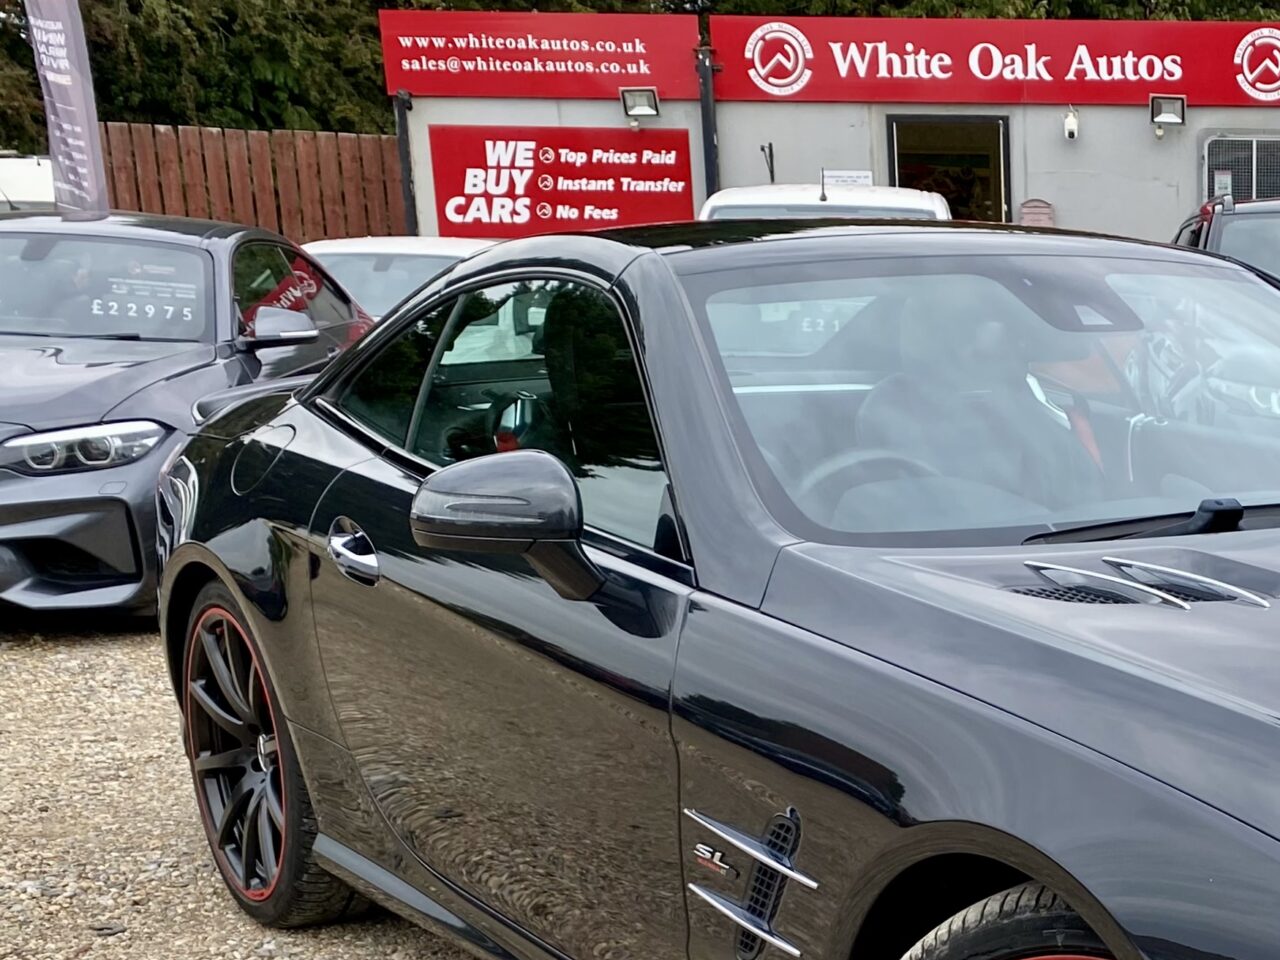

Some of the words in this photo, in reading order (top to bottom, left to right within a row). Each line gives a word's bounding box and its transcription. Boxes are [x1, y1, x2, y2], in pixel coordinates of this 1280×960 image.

[399, 33, 646, 53] www.whiteoakautos.co.uk
[401, 55, 651, 74] sales@whiteoakautos.co.uk
[828, 40, 953, 79] White
[968, 43, 1053, 81] Oak
[1065, 44, 1183, 82] Autos
[485, 140, 536, 167] WE
[558, 149, 587, 167] Top
[592, 149, 637, 164] Prices
[642, 150, 676, 165] Paid
[464, 168, 534, 195] BUY
[557, 177, 614, 191] Instant
[620, 177, 685, 192] Transfer
[445, 197, 531, 224] CARS
[556, 205, 578, 219] No
[584, 205, 618, 220] Fees
[91, 298, 192, 321] £22975
[694, 843, 730, 869] SL
